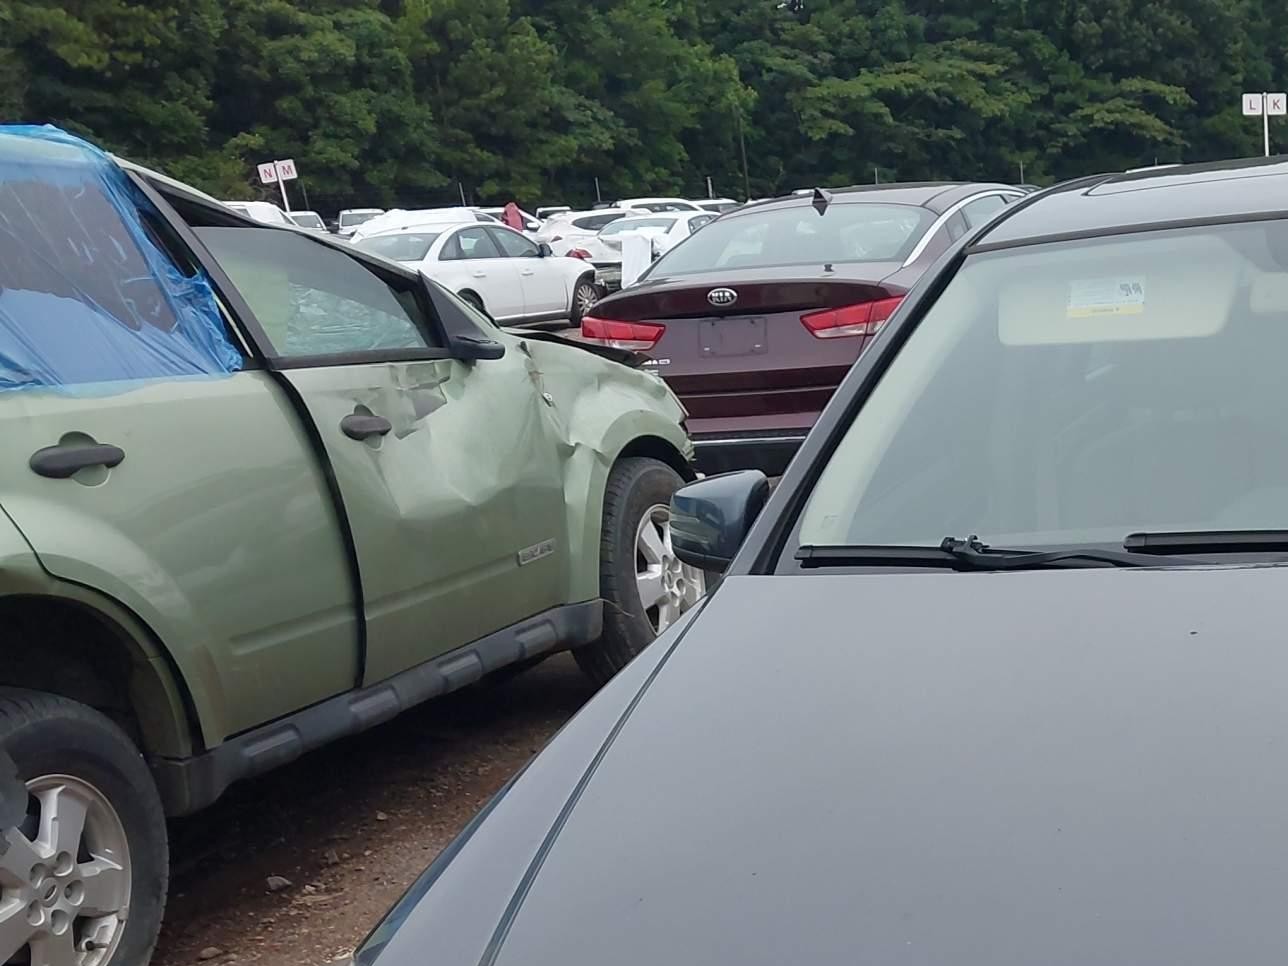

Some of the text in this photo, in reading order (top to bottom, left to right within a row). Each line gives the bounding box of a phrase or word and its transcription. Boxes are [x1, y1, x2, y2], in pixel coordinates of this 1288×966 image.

[1249, 99, 1256, 110] L
[1272, 99, 1281, 110] K
[263, 168, 273, 178] N
[282, 164, 293, 176] M
